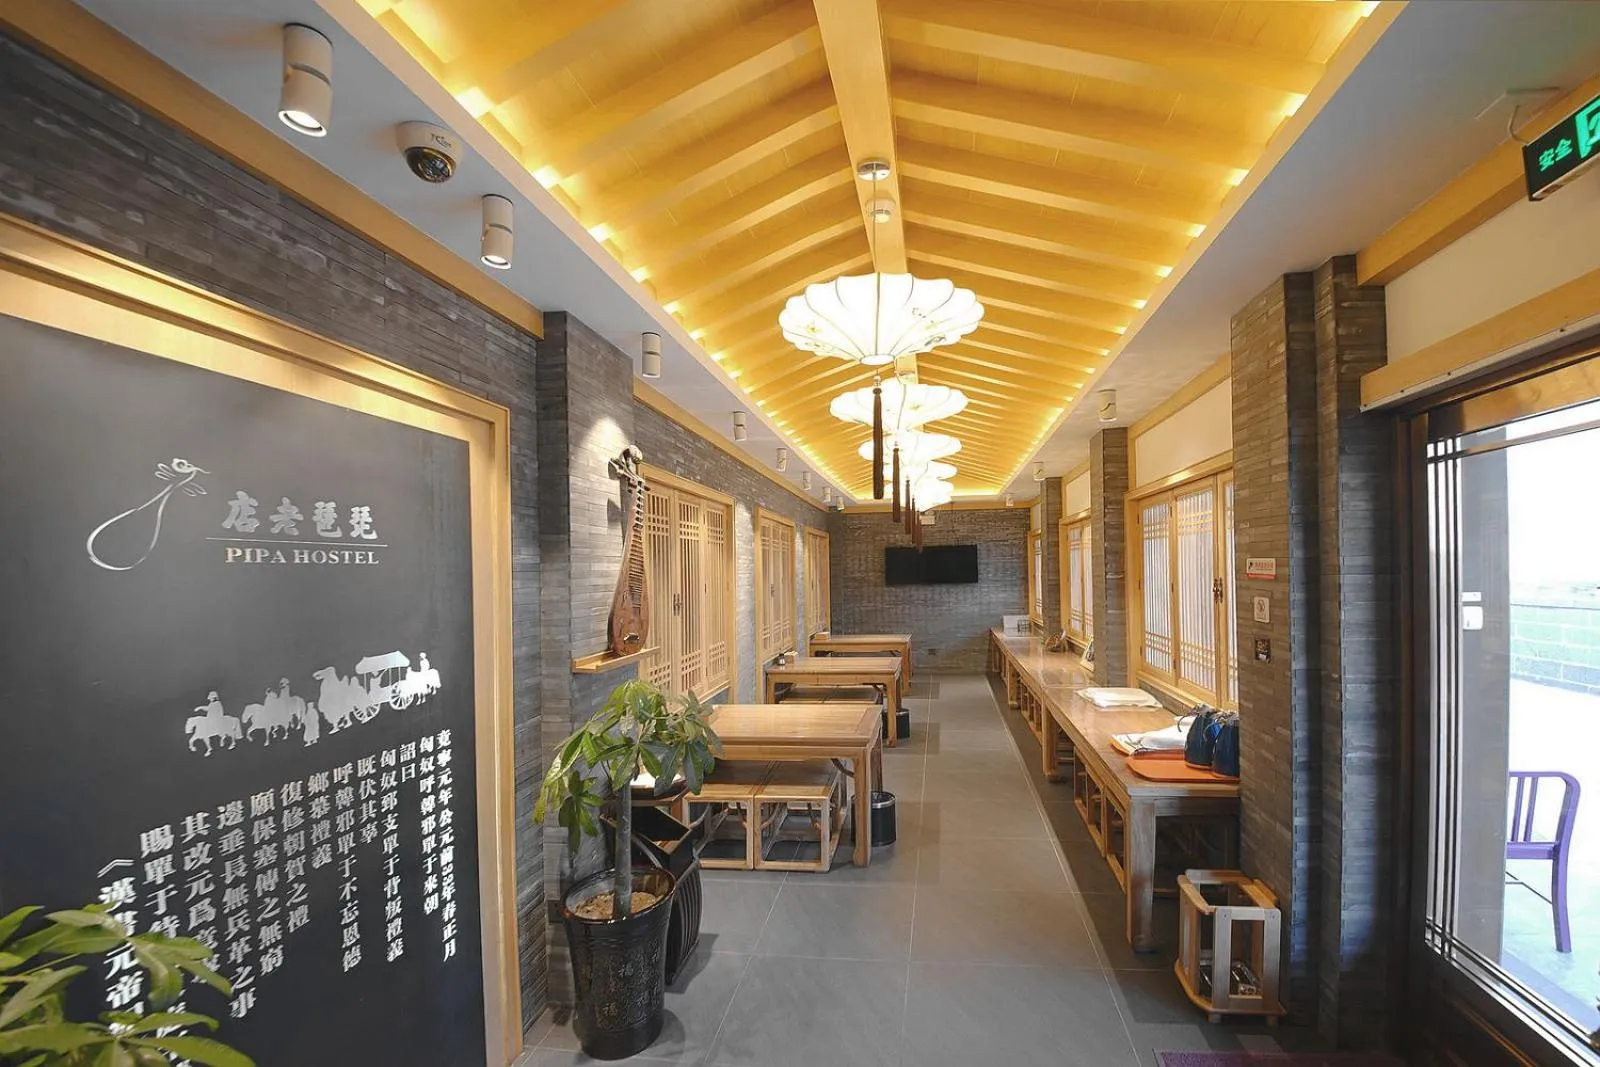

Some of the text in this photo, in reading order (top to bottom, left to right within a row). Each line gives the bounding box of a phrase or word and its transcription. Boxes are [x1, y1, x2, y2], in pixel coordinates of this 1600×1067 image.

[1538, 138, 1573, 172] 安全
[225, 547, 379, 565] PIPA HOSTEL
